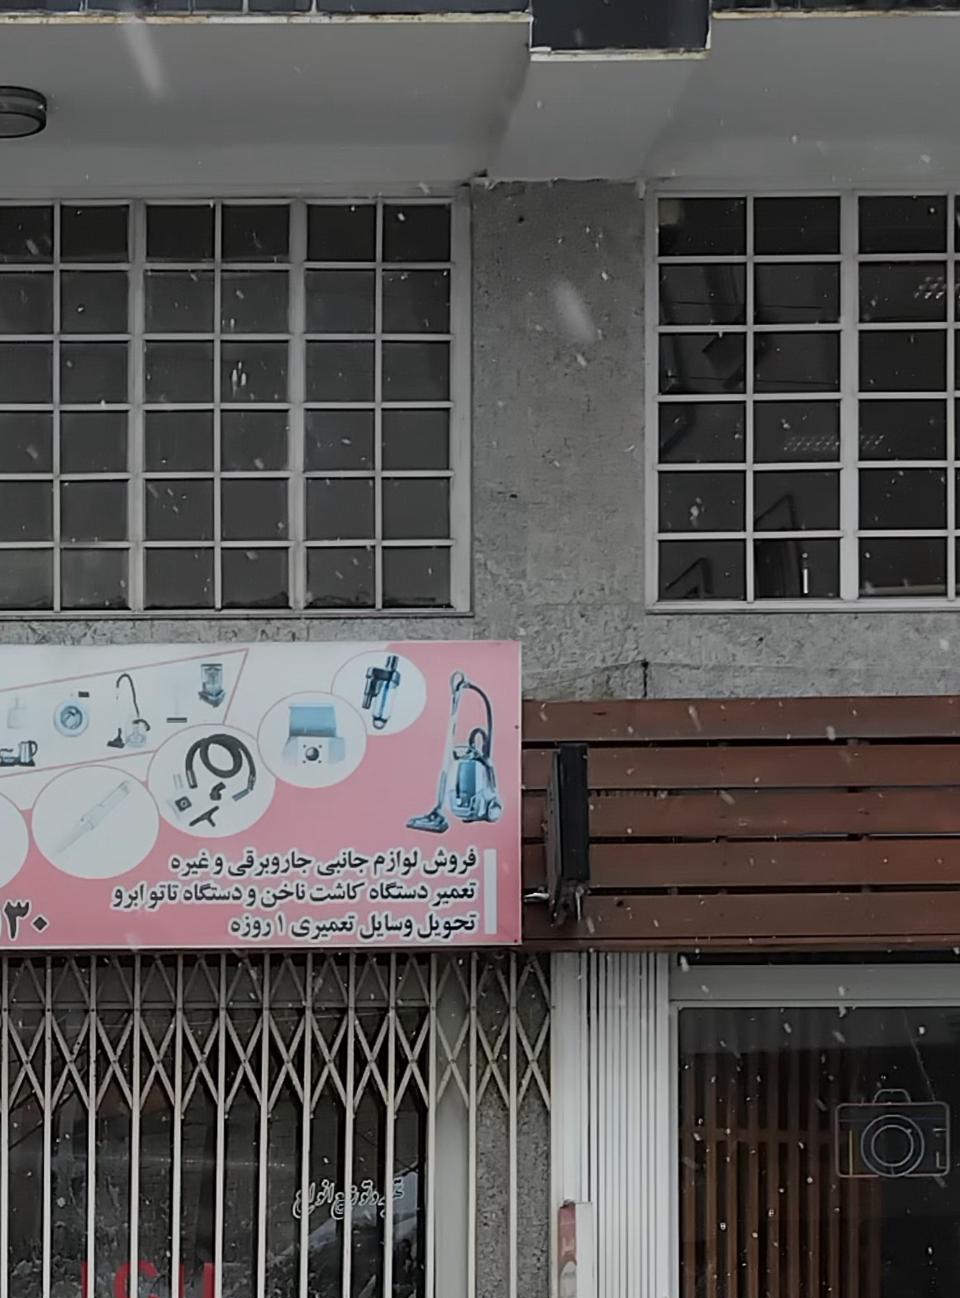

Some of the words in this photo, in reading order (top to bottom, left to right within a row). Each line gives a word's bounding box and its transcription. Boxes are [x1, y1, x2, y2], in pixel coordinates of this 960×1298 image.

[170, 853, 210, 877] غیره
[215, 859, 223, 875] و
[227, 850, 312, 877] جاروبرقی
[317, 851, 369, 876] جانبی
[373, 849, 418, 876] لوازم
[422, 848, 477, 876] فروش
[112, 884, 145, 909] ابرو
[149, 883, 179, 909] تاتو
[183, 883, 243, 901] دستگاه
[247, 890, 257, 908] و
[260, 883, 305, 908] ناخن
[310, 881, 365, 902] کاشت
[369, 881, 429, 903] دستگاه
[433, 881, 476, 907] تعمیر
[230, 914, 273, 938] روزه
[276, 914, 283, 930] ۱
[292, 914, 354, 940] تعمیری
[359, 913, 413, 940] وسایل
[418, 913, 476, 939] تحویل
